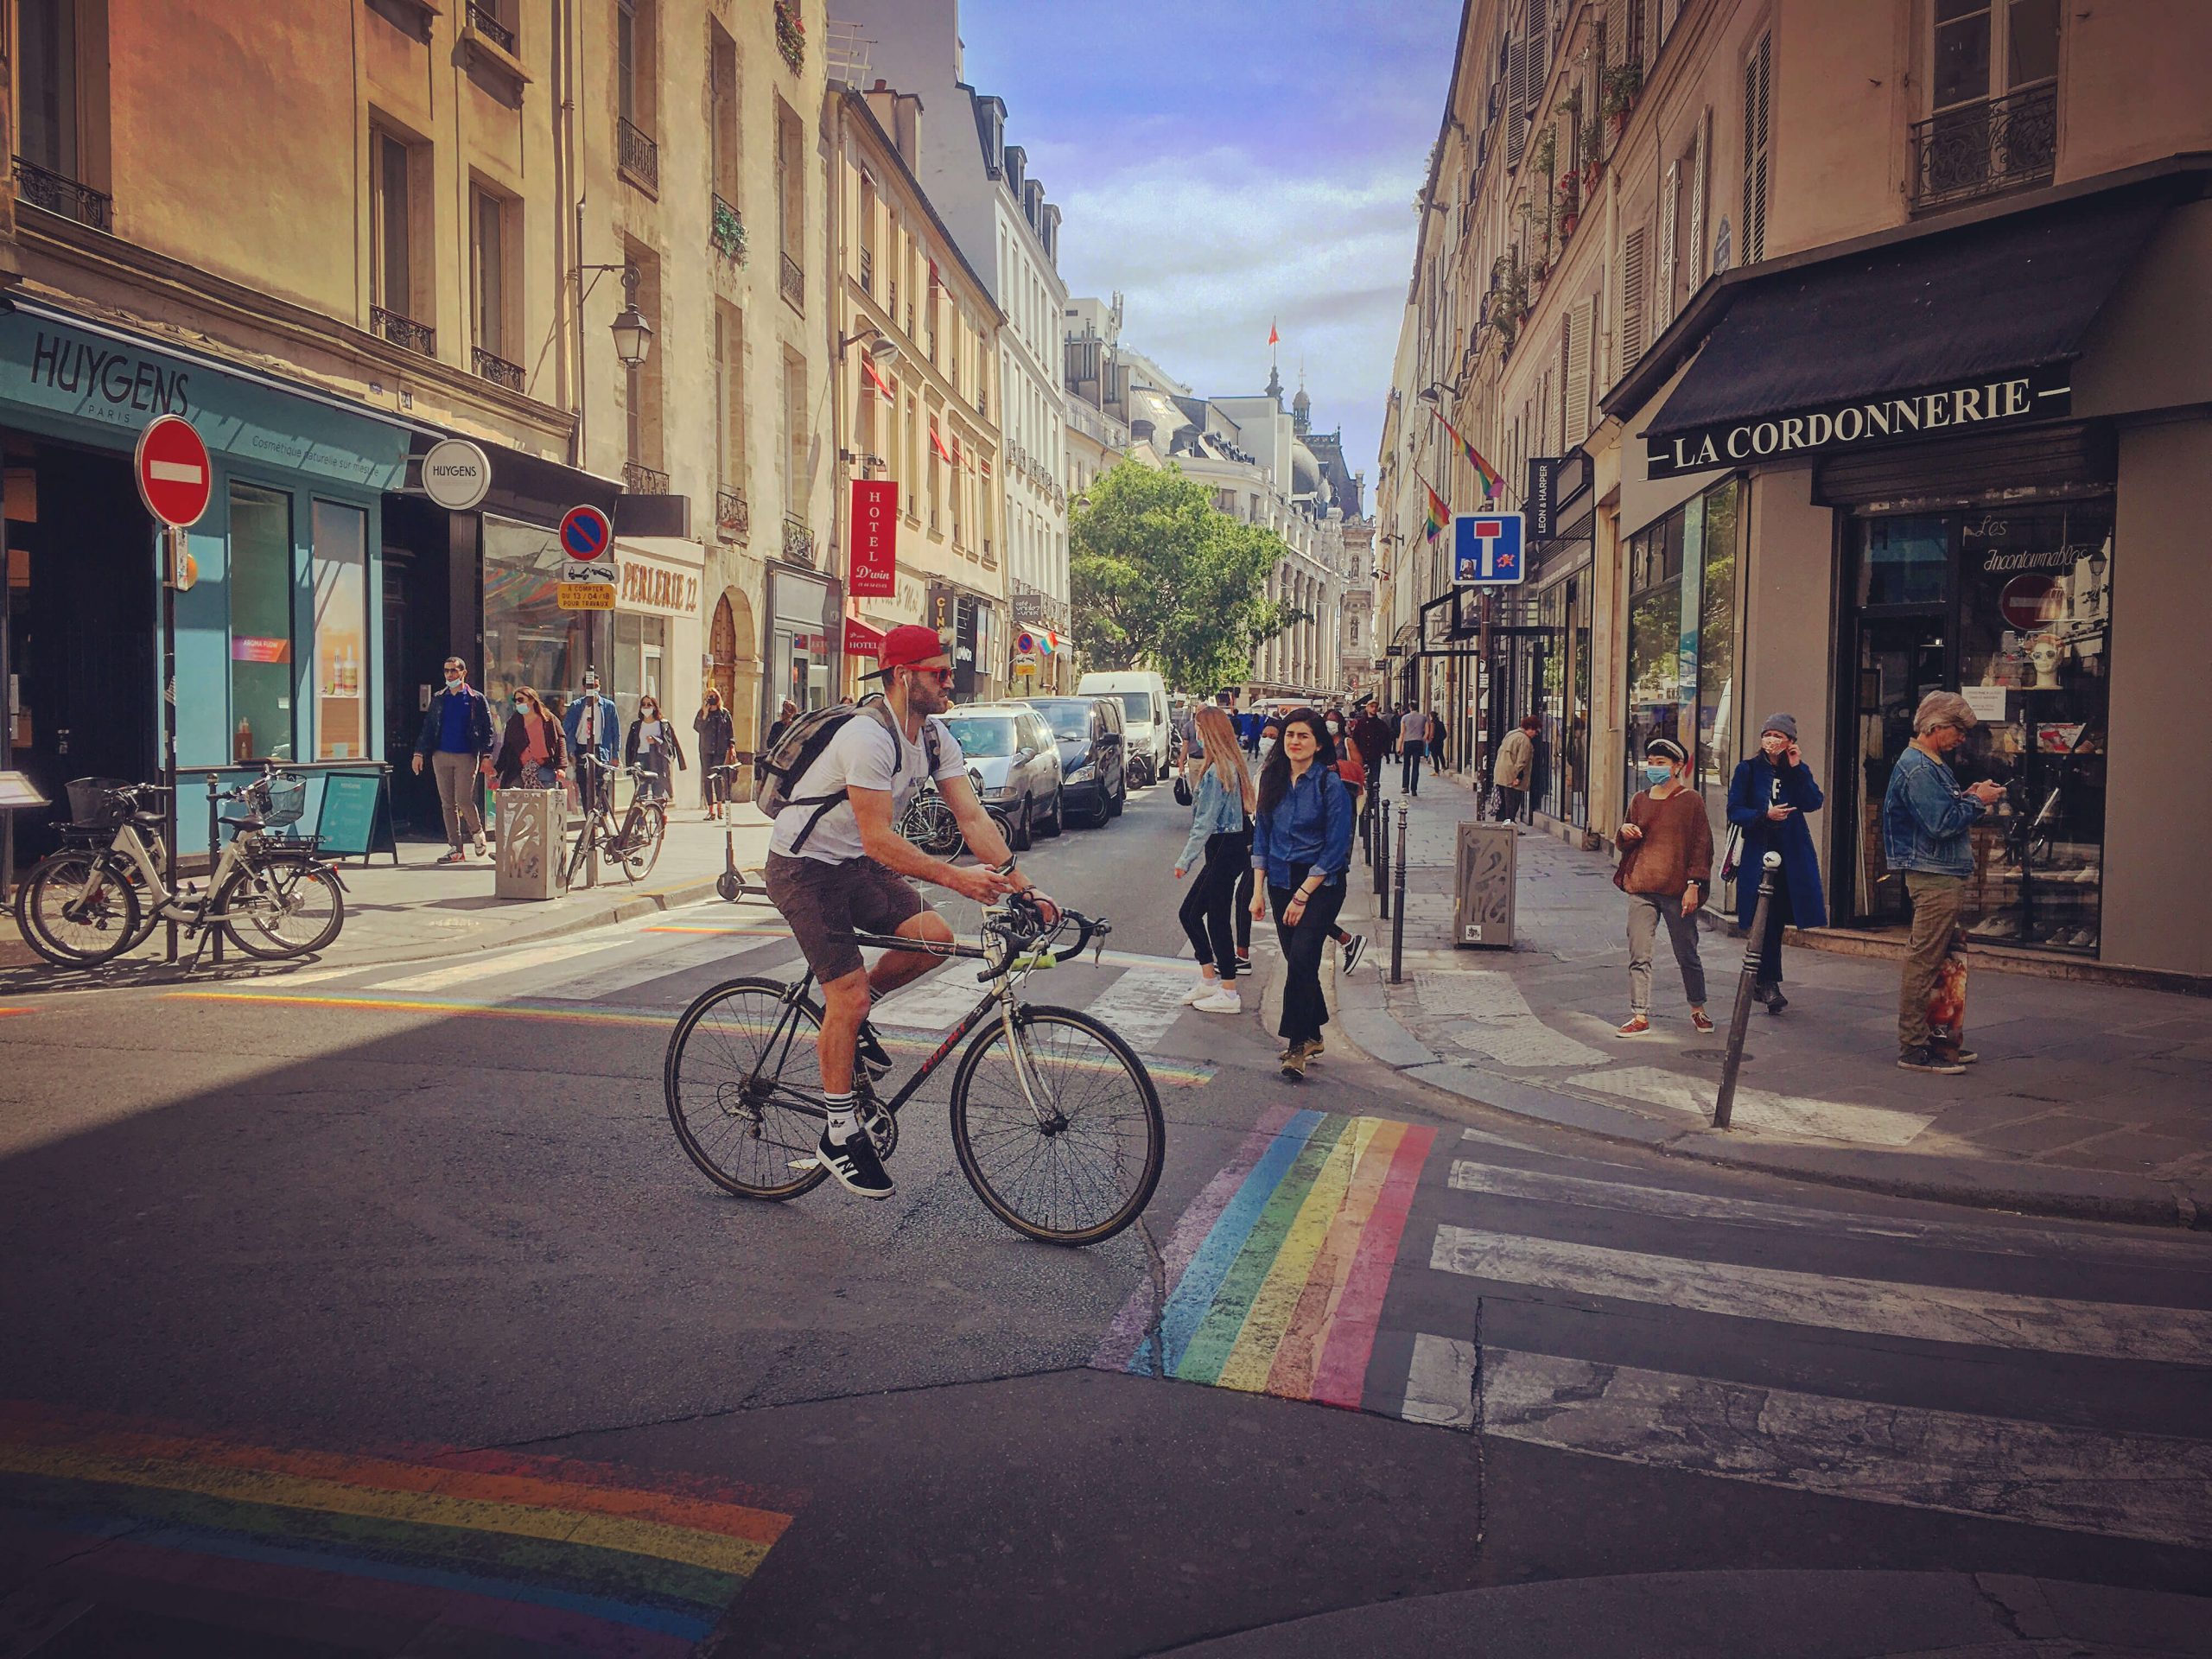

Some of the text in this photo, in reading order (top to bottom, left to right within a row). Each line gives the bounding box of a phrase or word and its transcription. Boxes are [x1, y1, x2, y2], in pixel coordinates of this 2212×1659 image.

[31, 332, 188, 417] HUYGENS
[88, 404, 130, 423] PARIS
[1673, 378, 2031, 468] LA CORDONNERIE
[252, 435, 302, 458] Cosmétique
[433, 466, 477, 477] HUYGENS
[1538, 465, 1548, 501] HARPER
[868, 492, 881, 562] HOTEL
[1538, 510, 1547, 533] LEON
[621, 562, 684, 610] PERLERIE
